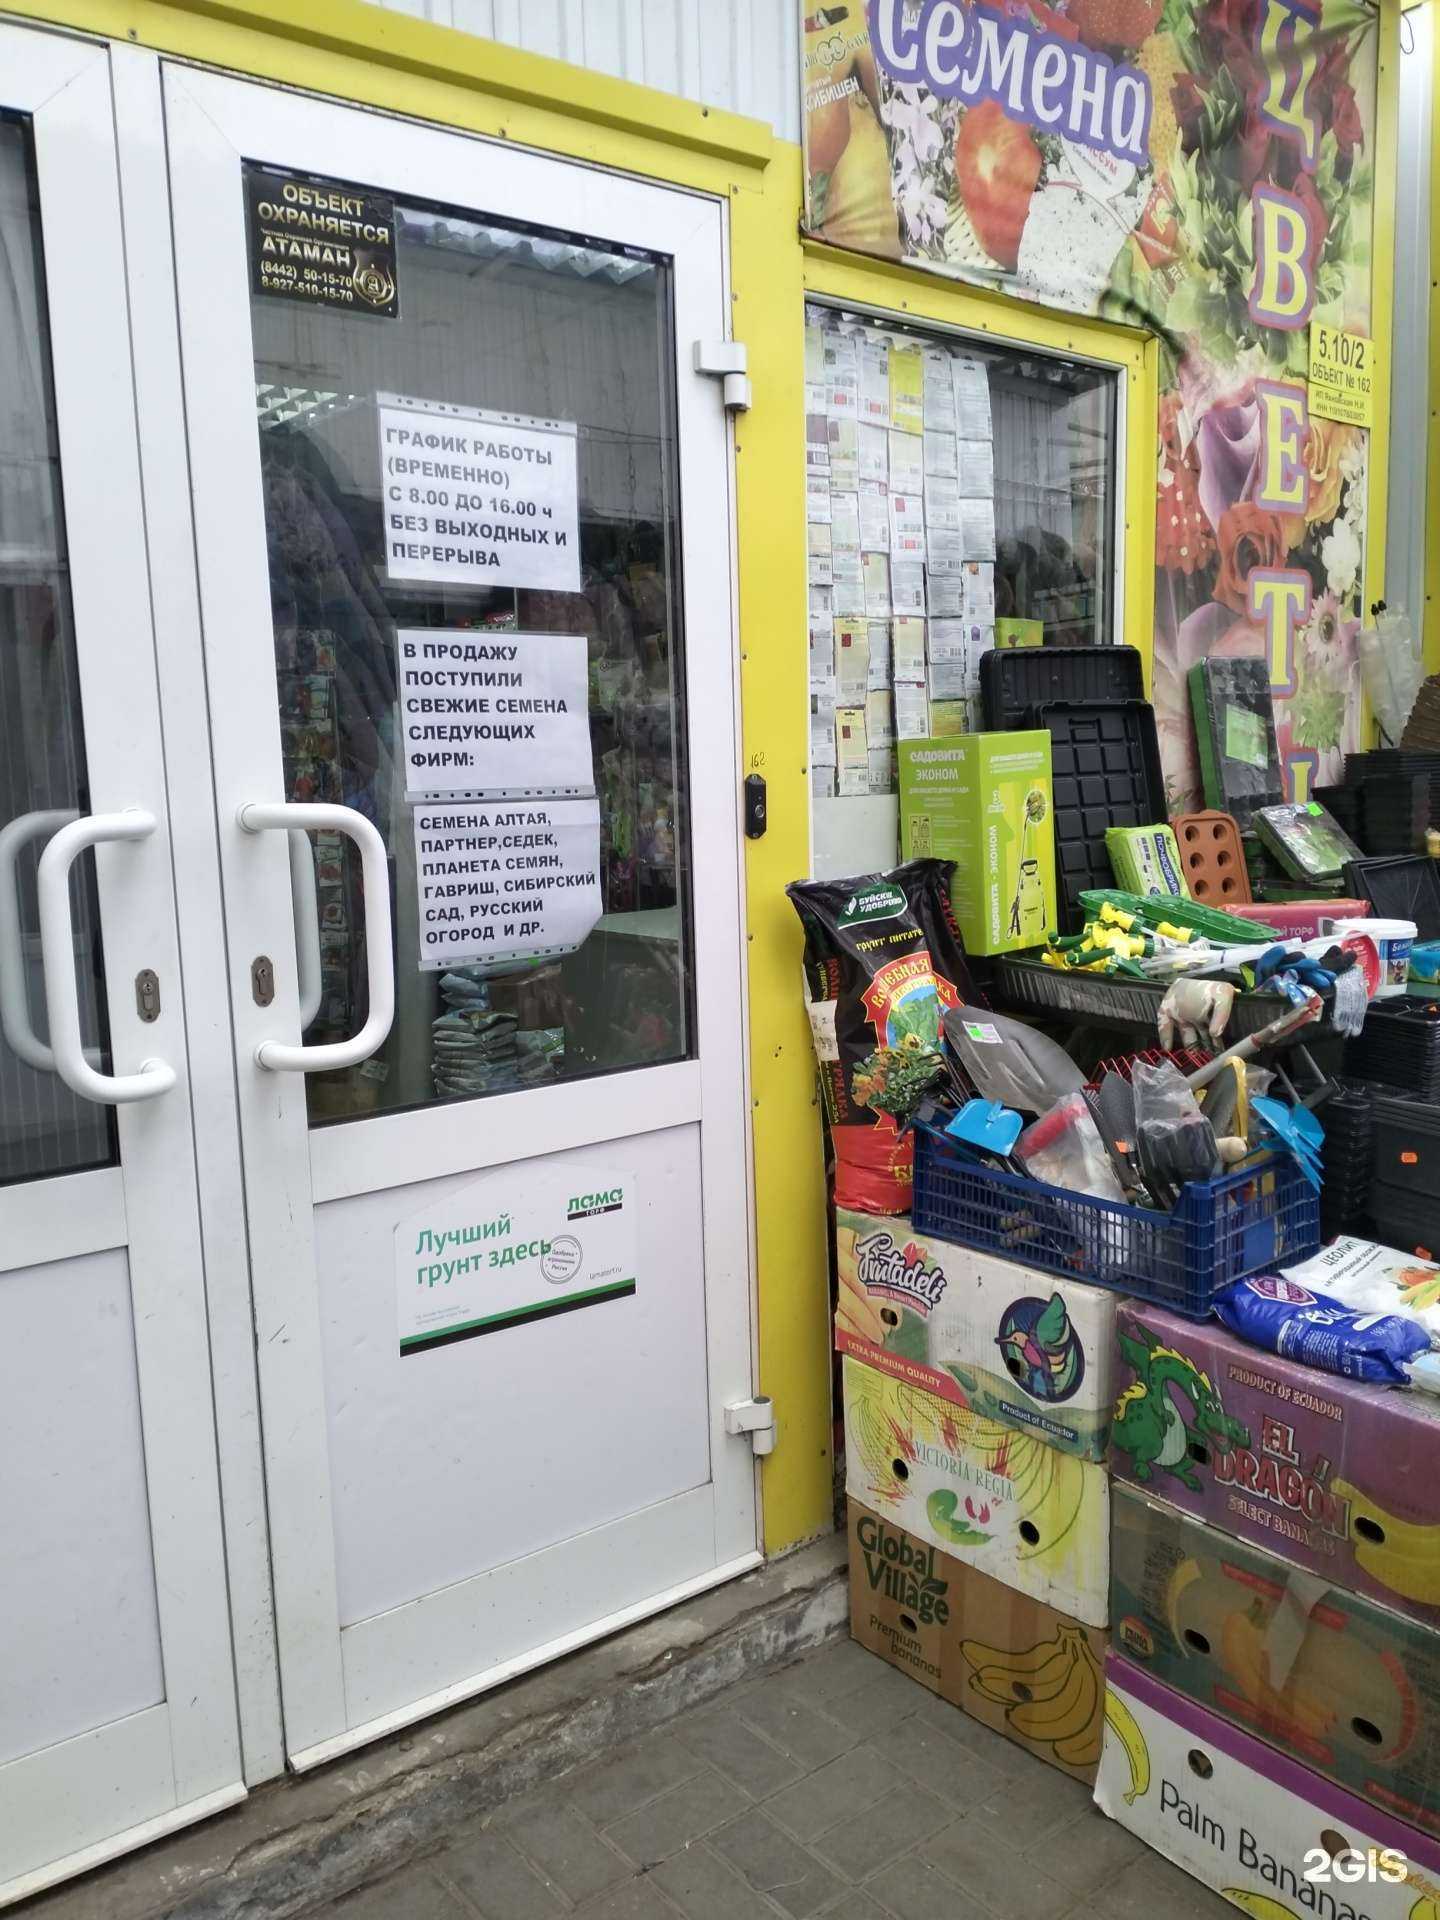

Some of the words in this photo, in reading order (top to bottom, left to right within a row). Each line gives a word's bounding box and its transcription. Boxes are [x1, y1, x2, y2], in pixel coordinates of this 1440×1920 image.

[879, 0, 1147, 155] Семена
[282, 184, 364, 217] ОБЪЕКТ
[258, 202, 389, 244] ОХРАНЯЕТСЯ
[262, 236, 351, 268] АТАМАН
[260, 260, 298, 279] (8442)
[303, 268, 352, 288] 50-15-70
[261, 276, 354, 301] 8-927-510-15-70
[1319, 329, 1365, 370] 5.10/2
[1312, 362, 1344, 386] ОБЪЕКТ
[1346, 373, 1355, 388] №
[1357, 377, 1371, 393] 162
[386, 428, 468, 454] ГРАФИК
[473, 440, 552, 465] РАБОТЫ
[388, 456, 510, 490] (ВРЕМЕННО)
[389, 486, 402, 501] С
[409, 488, 449, 506] 8.00
[455, 493, 482, 511] ДО
[490, 499, 536, 517] 16.00
[542, 506, 553, 518] ч
[390, 514, 428, 532] БЕЗ
[435, 519, 549, 545] ВЫХОДНЫХ
[555, 532, 567, 546] И
[392, 543, 501, 567] ПЕРЕРЫВА
[404, 643, 416, 658] В
[423, 644, 518, 662] ПРОДАЖУ
[405, 671, 523, 687] ПОСТУПИЛИ
[407, 698, 490, 714] СВЕЖИЕ
[496, 699, 568, 714] СЕМЕНА
[409, 725, 536, 742] СЛЕДУЮЩИХ
[411, 752, 475, 768] ФИРМ:
[915, 768, 959, 781] ЭКОНОМ
[420, 815, 490, 830] СЕМЕНА
[494, 812, 552, 827] АЛТАЯ,
[422, 859, 501, 876] ПЛАНЕТА
[505, 855, 563, 870] СЕМЯН,
[424, 882, 499, 899] ГАВРИШ,
[504, 871, 596, 893] СИБИРСКИЙ
[425, 907, 465, 922] САД,
[470, 897, 544, 918] РУССКИЙ
[426, 926, 495, 944] ОГОРОД
[504, 923, 514, 937] И
[519, 921, 544, 937] ДР.
[1288, 926, 1314, 936] ТОРФ
[567, 1188, 623, 1212] лама
[416, 1212, 512, 1256] Лучший
[417, 1253, 482, 1287] грунт
[488, 1239, 551, 1268] здесь
[847, 1341, 868, 1358] EXTRA
[872, 1350, 905, 1372] PREMIUM
[906, 1366, 941, 1388] QUALITY
[1228, 1365, 1276, 1395] PRODUCT
[1278, 1382, 1291, 1400] OF
[1292, 1390, 1343, 1421] ECUADOR
[1002, 1402, 1031, 1422] Product
[1032, 1415, 1040, 1424] of
[1041, 1419, 1075, 1438] Ecuador
[1263, 1416, 1299, 1466] EL
[914, 1440, 970, 1481] VICTORIA
[976, 1467, 1017, 1500] REGIA
[1227, 1495, 1272, 1527] SELECT
[857, 1516, 936, 1579] Global
[864, 1550, 950, 1626] Village
[870, 1614, 922, 1654] Premium
[890, 1637, 942, 1680] bananas
[1160, 1778, 1225, 1852] Palm
